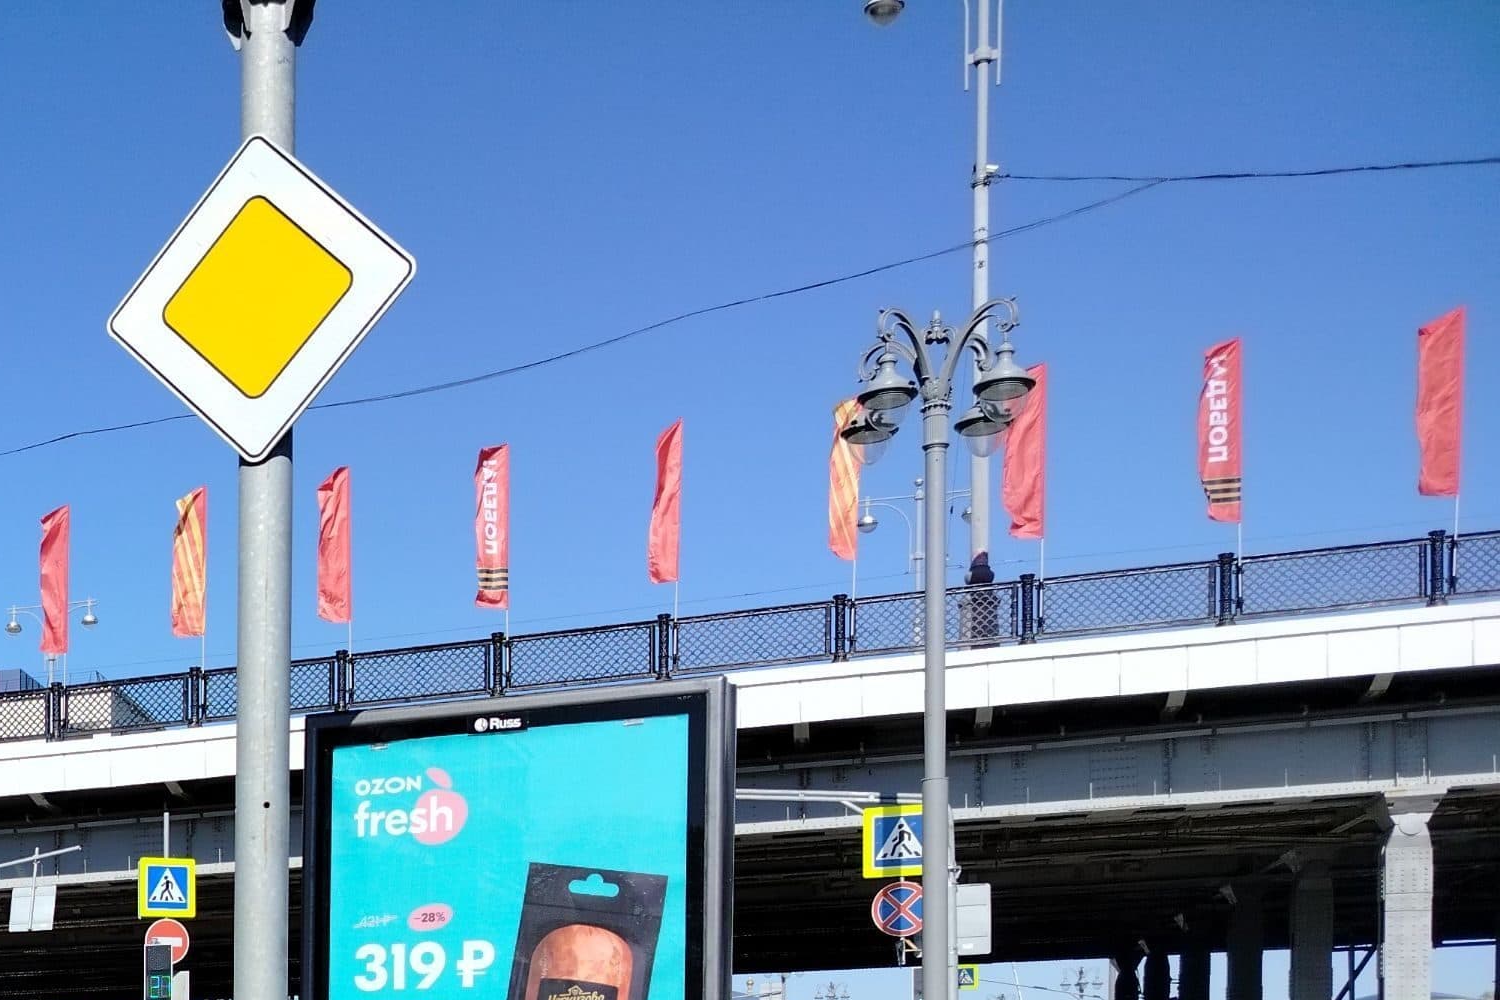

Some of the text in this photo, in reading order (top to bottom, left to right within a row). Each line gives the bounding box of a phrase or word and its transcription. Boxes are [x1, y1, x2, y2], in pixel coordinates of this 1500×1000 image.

[489, 717, 522, 730] Russ
[354, 796, 453, 837] fresh
[354, 941, 446, 992] 319
[456, 940, 496, 988] ₽
